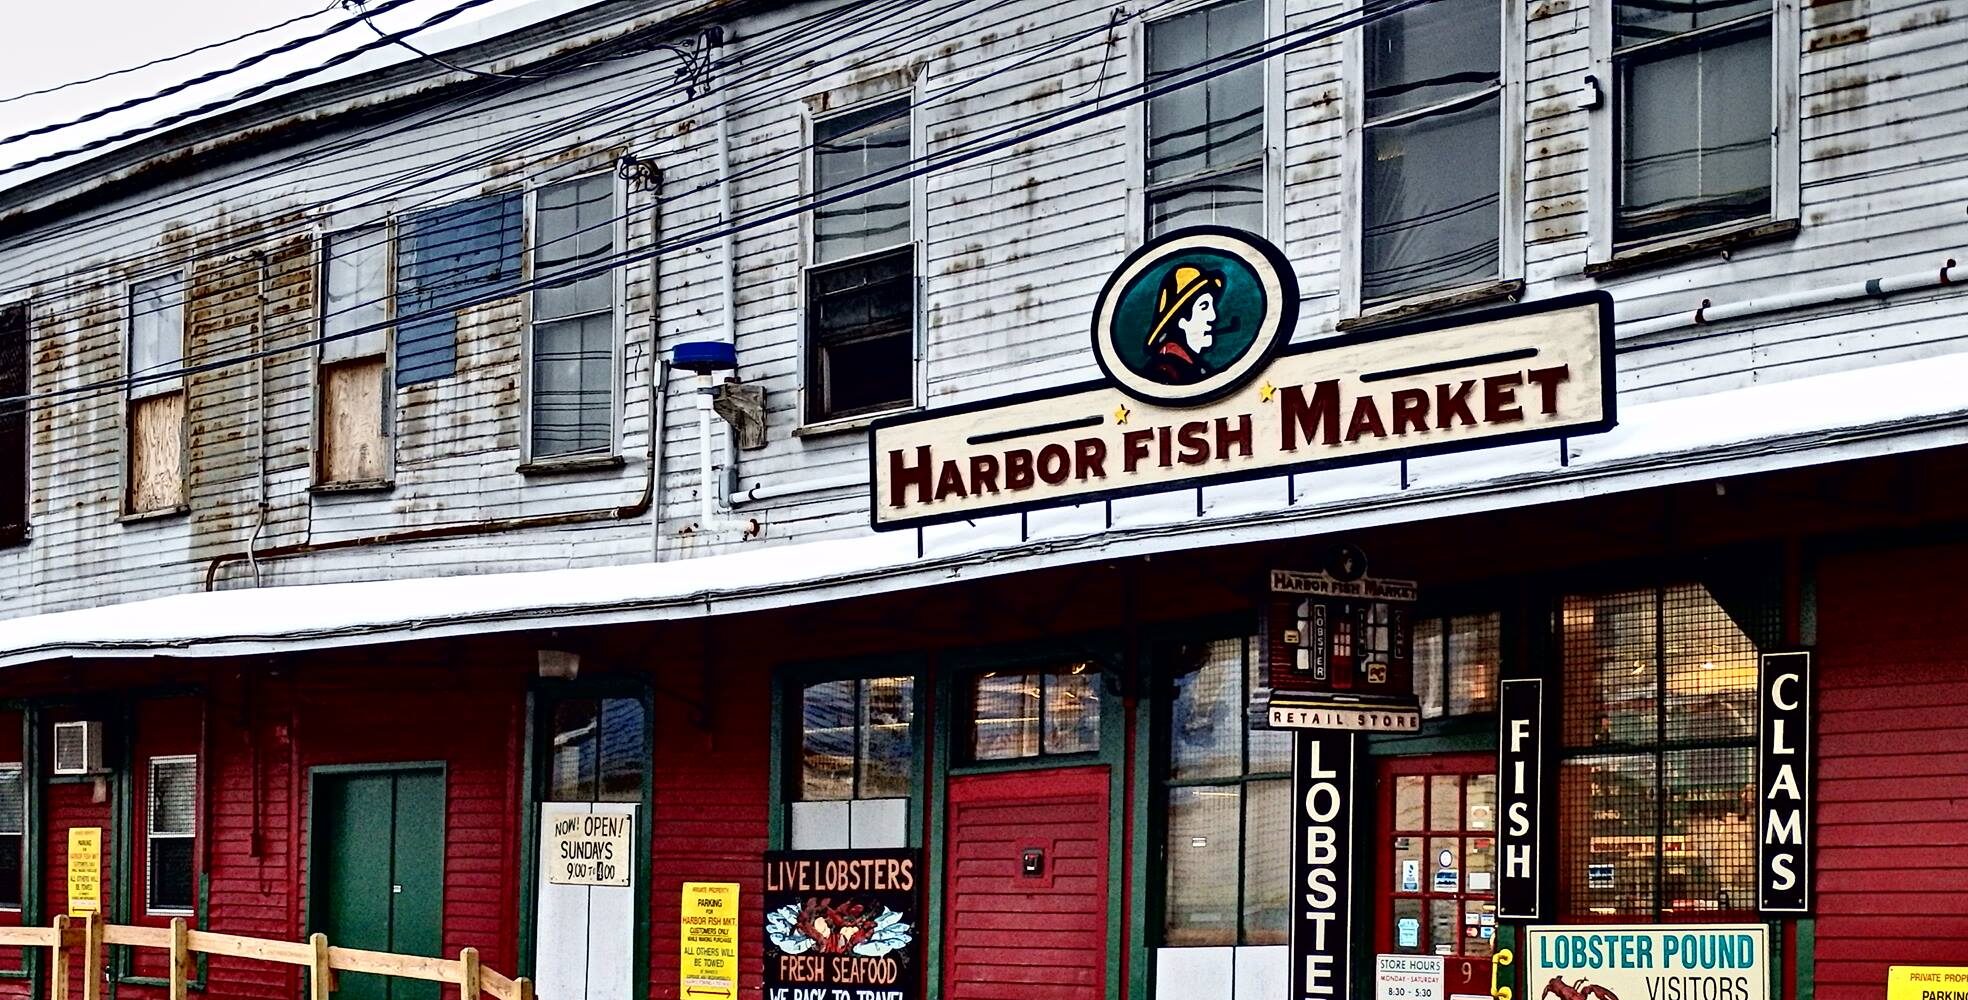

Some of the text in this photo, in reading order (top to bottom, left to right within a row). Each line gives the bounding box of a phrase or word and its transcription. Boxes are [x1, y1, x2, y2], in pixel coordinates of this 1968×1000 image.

[888, 363, 1569, 508] HARBOR FISH MARKET
[1274, 573, 1416, 599] HARBOR FISH MARKET
[1316, 607, 1324, 676] LOBSTER
[1274, 711, 1416, 727] RETAIL STORE
[1765, 673, 1802, 890] CLAMS
[1506, 720, 1531, 878] FISH
[555, 816, 624, 838] NOW! OPEN!
[561, 841, 613, 860] SUNDAYS
[767, 859, 914, 891] LIVE LOBSTERS
[1305, 740, 1341, 1000] LOBSTE
[698, 898, 722, 908] PARKING
[683, 916, 706, 925] HARBOR
[708, 917, 721, 926] FISH
[690, 927, 716, 935] CUSTOMERS
[684, 946, 735, 957] ALL OTHERS WILL
[1541, 934, 1754, 969] LOBSTER POUND
[694, 958, 724, 968] BE TOWED
[780, 955, 897, 984] FRESH SEAFOOD
[1381, 959, 1440, 971] STORE HOURS
[1461, 961, 1472, 984] 9
[1646, 976, 1749, 1000] VISITORS
[1910, 973, 1941, 983] PRIVATE
[1388, 987, 1405, 996] 8:30
[1415, 988, 1432, 997] 5:30
[1923, 990, 1968, 1000] PARKIN
